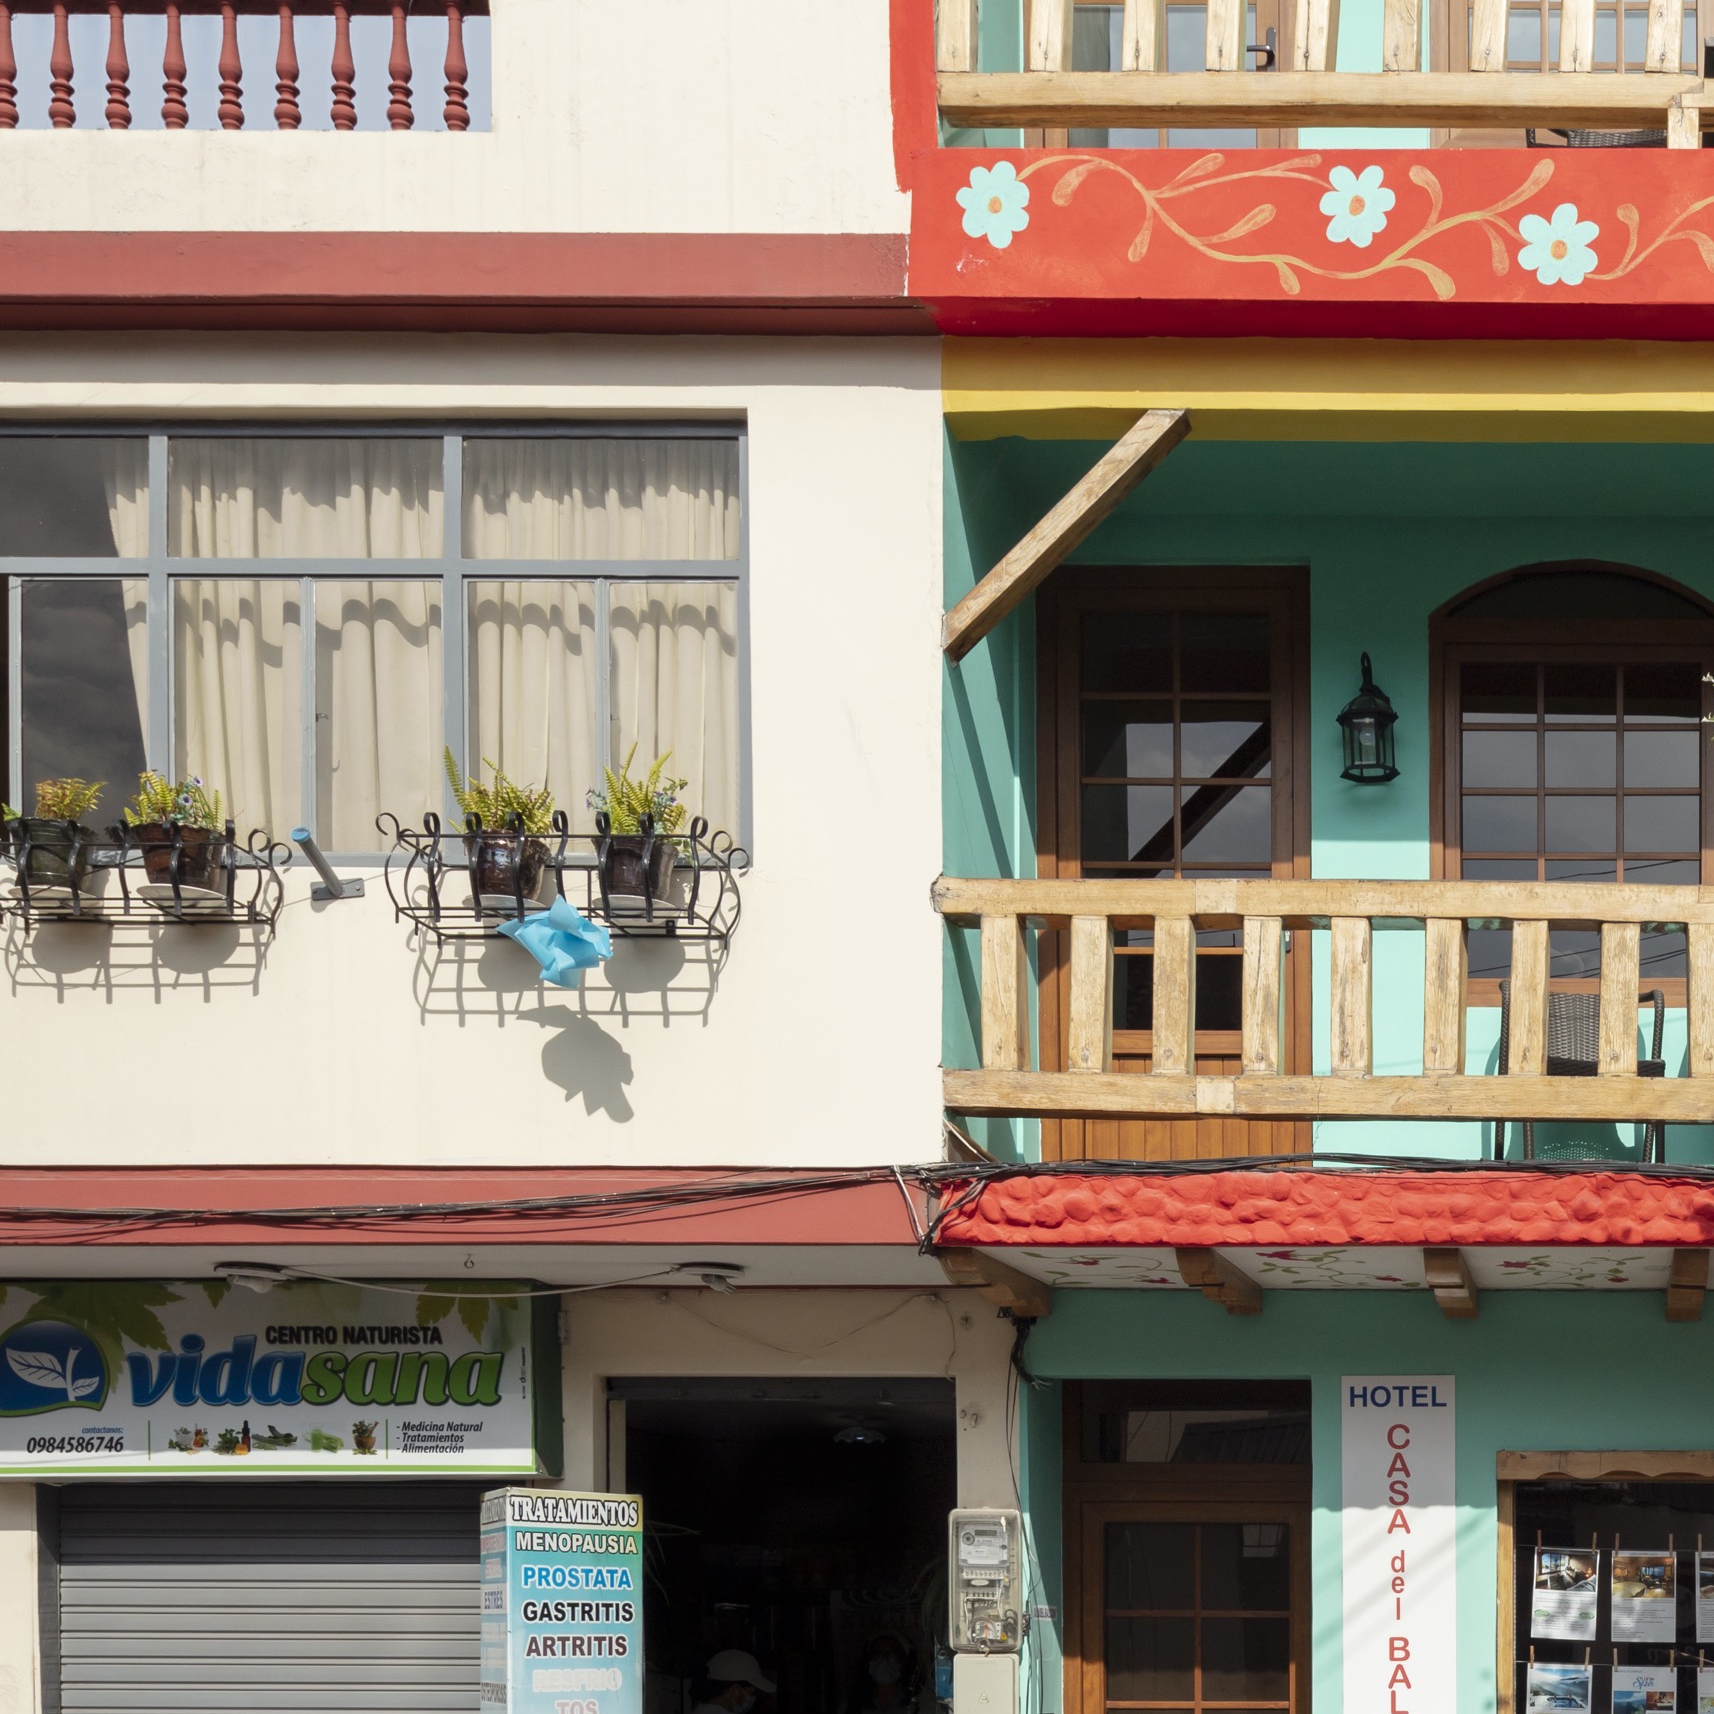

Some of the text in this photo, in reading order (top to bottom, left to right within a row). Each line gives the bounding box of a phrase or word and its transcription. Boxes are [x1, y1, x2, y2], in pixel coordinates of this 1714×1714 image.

[265, 1325, 443, 1345] CENTRO NATURISTA
[1349, 1385, 1447, 1408] HOTEL
[401, 1421, 483, 1432] Medicina Natural
[401, 1432, 464, 1443] Tratamientos
[26, 1436, 124, 1454] 0984586746
[401, 1443, 464, 1454] Alimentación
[1387, 1423, 1411, 1535] CASA
[510, 1495, 639, 1526] TRATAMIENTOS
[515, 1531, 638, 1554] MENOPAUSIA
[523, 1566, 632, 1589] PROSTATA
[1390, 1549, 1405, 1620] del
[523, 1601, 634, 1622] GASTRITIS
[525, 1635, 628, 1657] ARTRITIS
